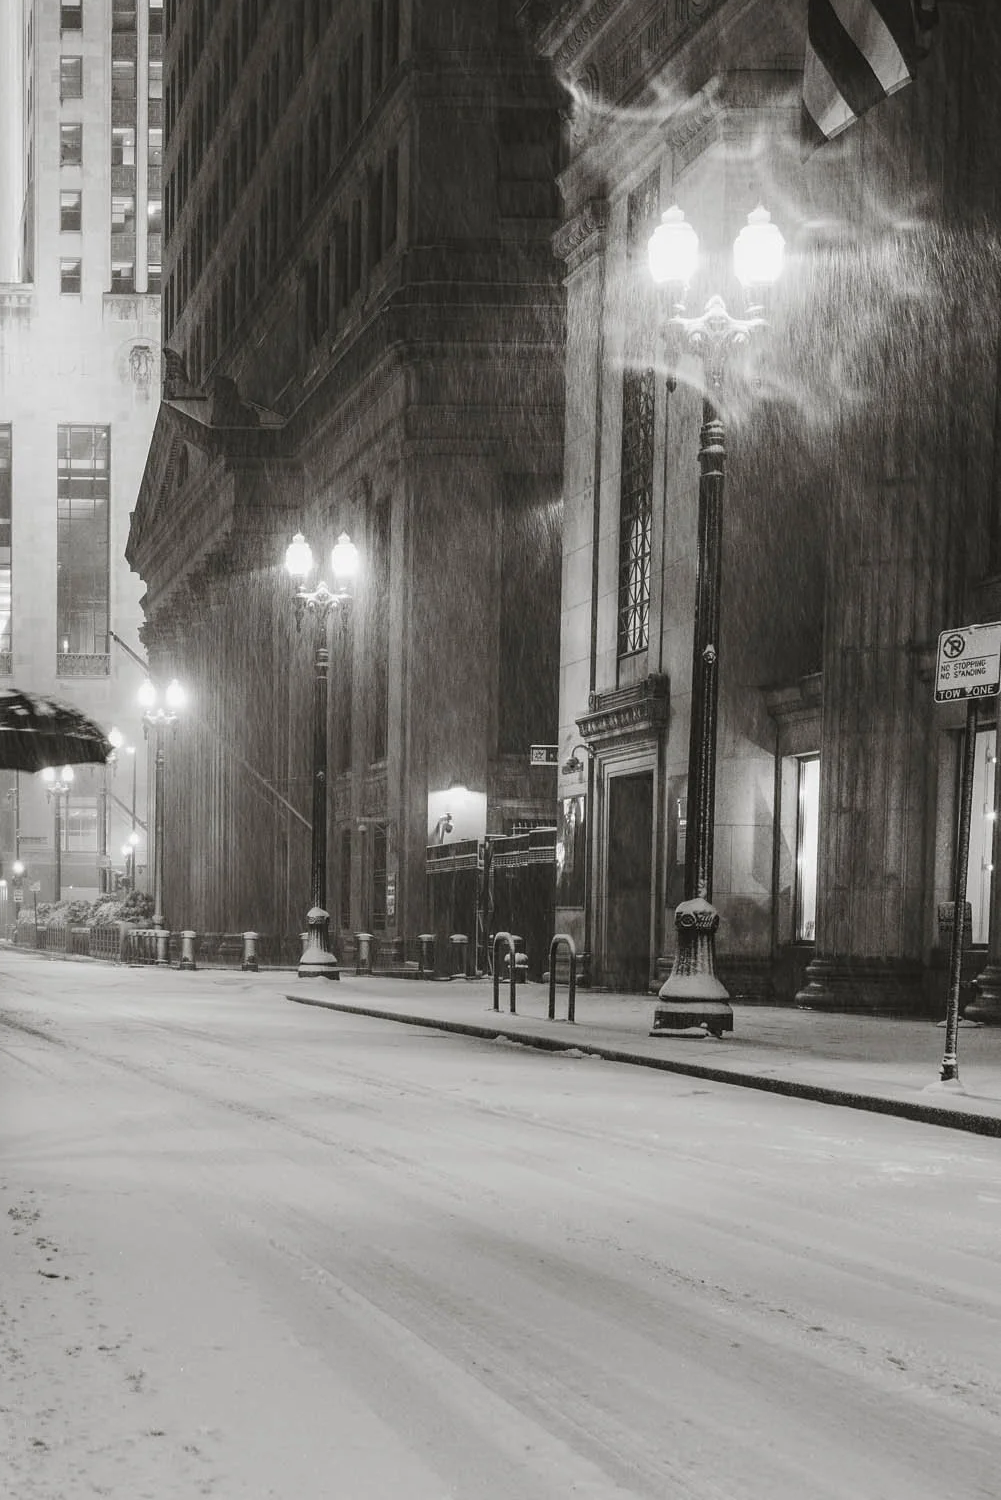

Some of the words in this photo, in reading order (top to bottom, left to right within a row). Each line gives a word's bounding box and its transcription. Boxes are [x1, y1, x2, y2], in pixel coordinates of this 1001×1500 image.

[1, 351, 91, 378] TRDE
[940, 664, 950, 672] NO
[953, 659, 986, 671] STOPPING
[940, 672, 950, 680] NO
[953, 668, 986, 678] STANDING
[939, 689, 961, 700] TOW
